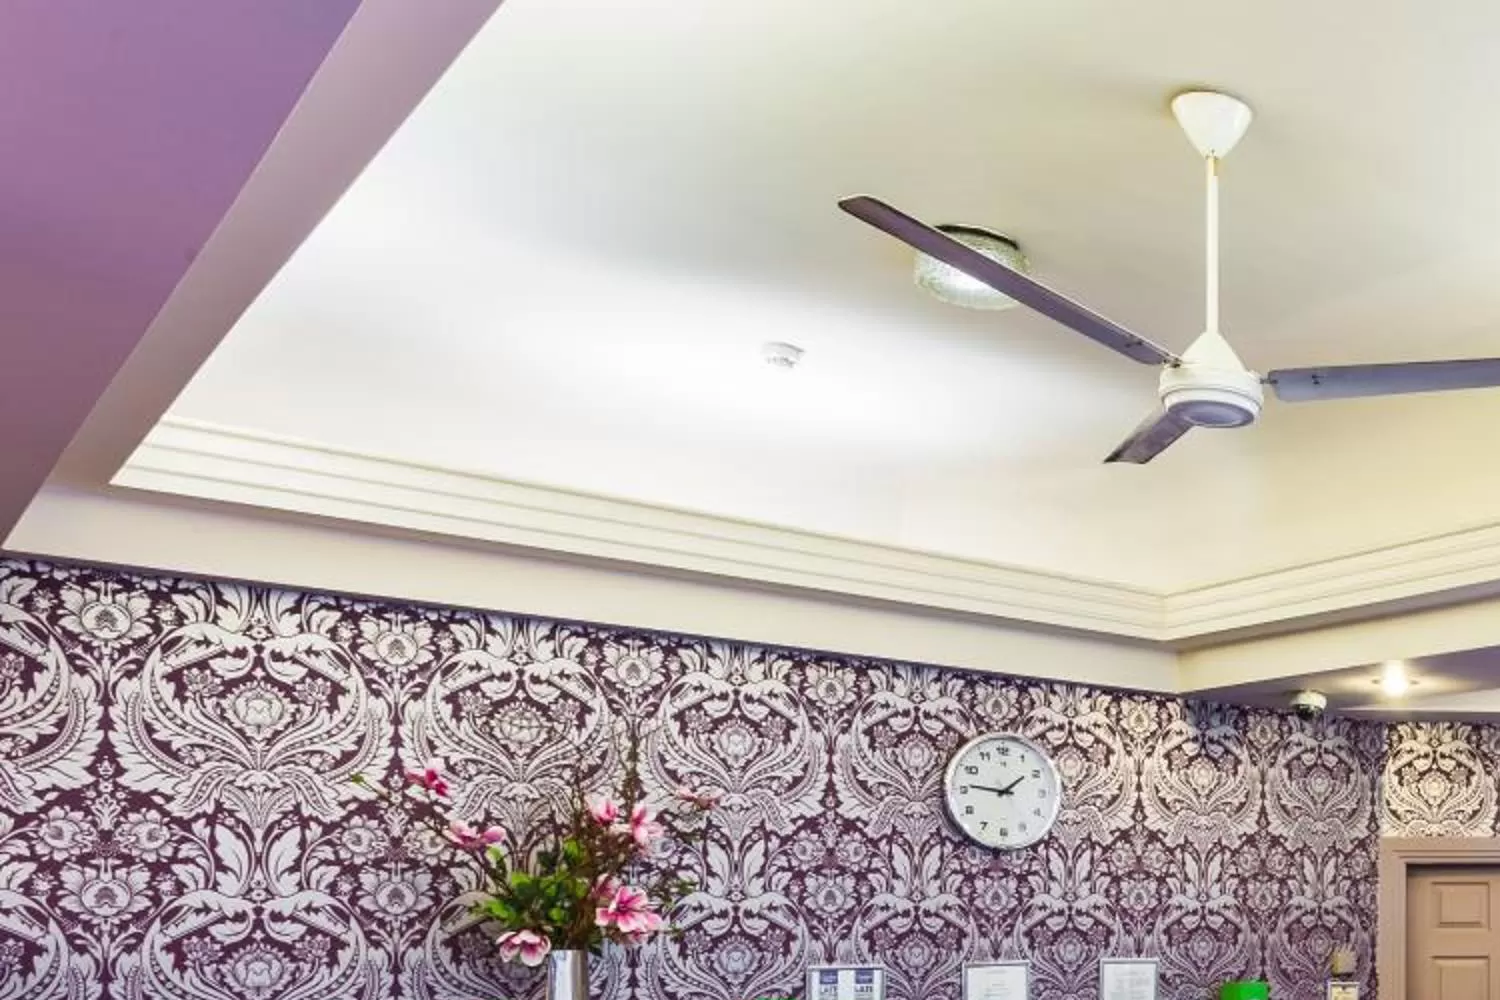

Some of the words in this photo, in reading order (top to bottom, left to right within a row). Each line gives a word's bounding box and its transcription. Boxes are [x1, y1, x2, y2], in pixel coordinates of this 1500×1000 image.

[979, 751, 991, 761] 11
[996, 746, 1009, 756] 12
[964, 765, 979, 775] 10
[1032, 769, 1041, 778] 2
[980, 821, 988, 830] 7
